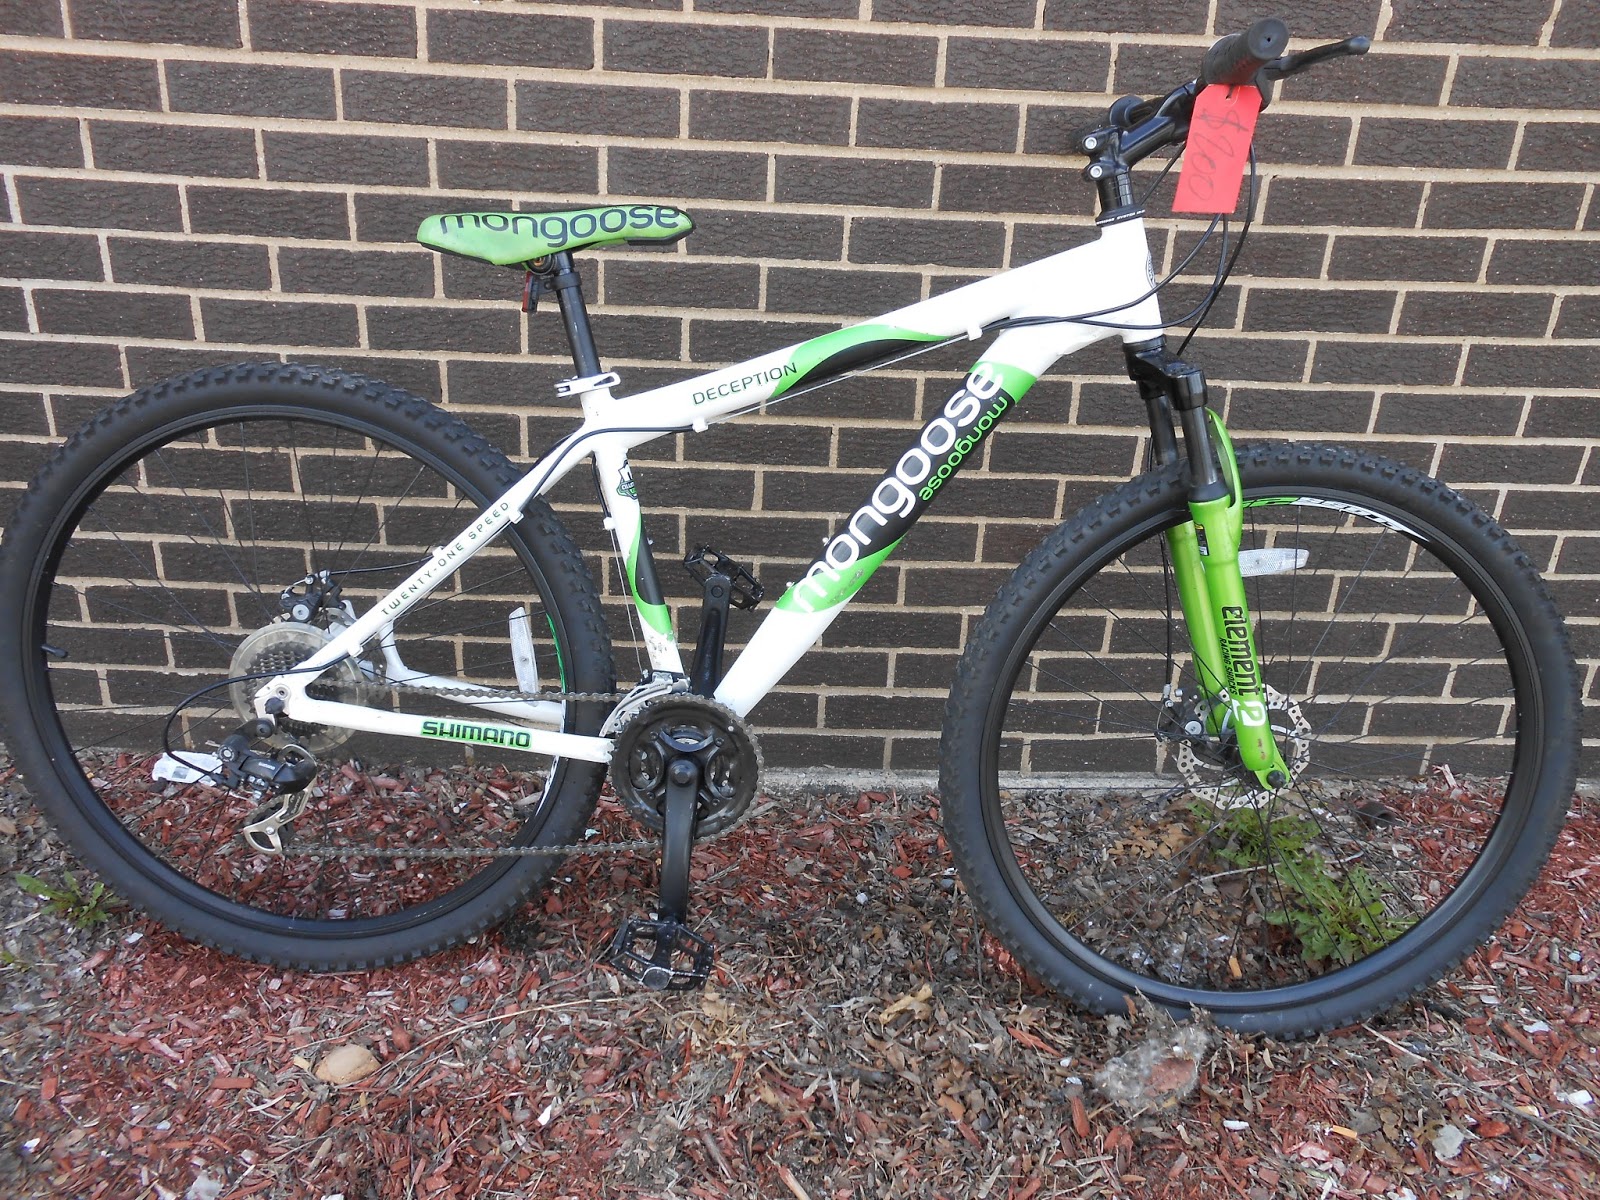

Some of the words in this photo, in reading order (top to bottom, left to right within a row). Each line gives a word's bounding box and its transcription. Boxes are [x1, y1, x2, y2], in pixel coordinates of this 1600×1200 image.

[440, 205, 680, 248] mongoose
[692, 361, 798, 405] DECEPTION
[792, 361, 1004, 614] mongoose
[918, 396, 1008, 501] mongoose
[380, 542, 464, 616] TWENTY-ONE
[468, 502, 509, 540] SPEED
[1221, 605, 1261, 697] element
[422, 720, 531, 748] SHIMANO
